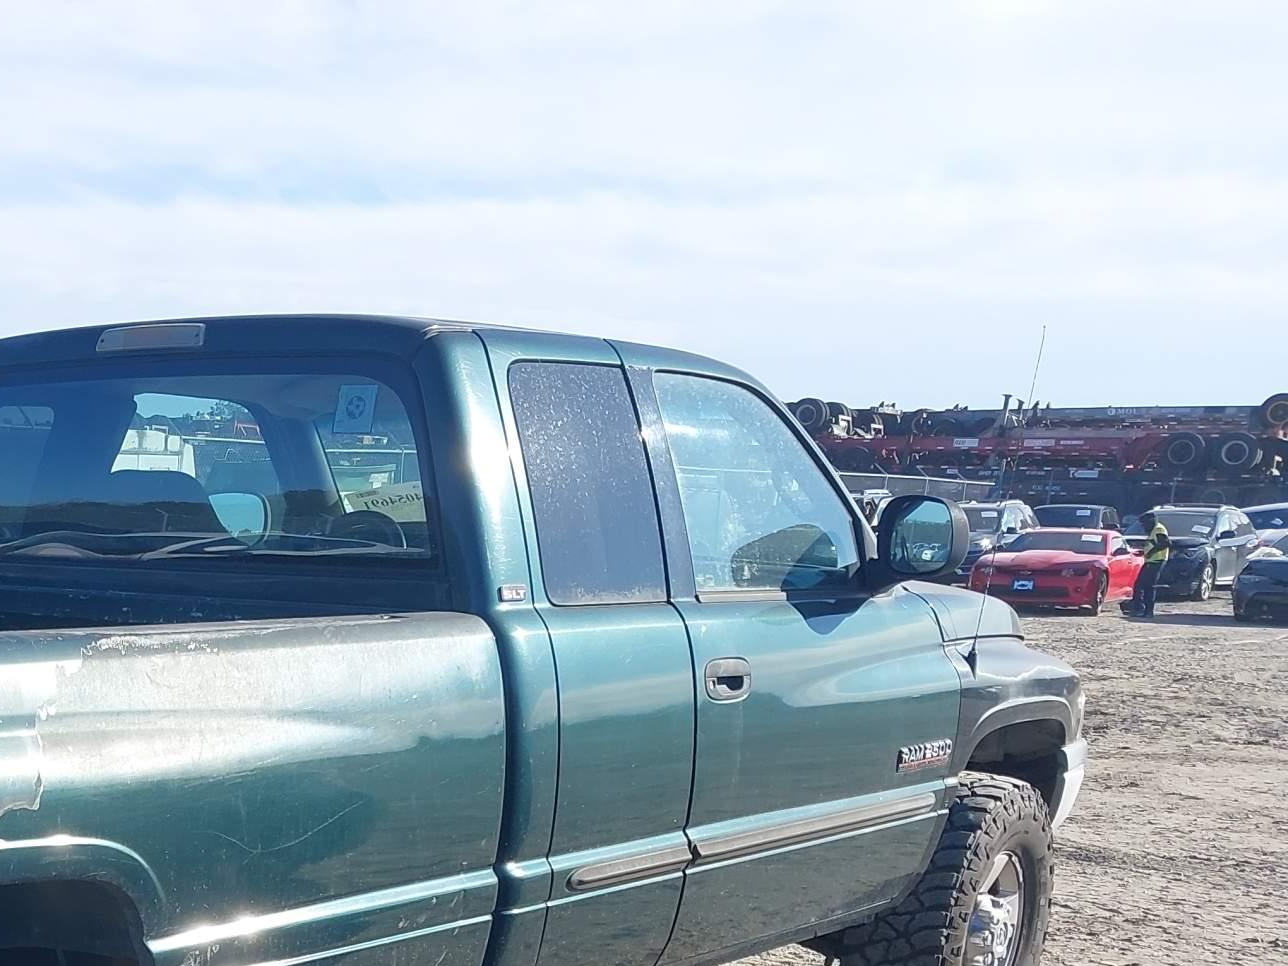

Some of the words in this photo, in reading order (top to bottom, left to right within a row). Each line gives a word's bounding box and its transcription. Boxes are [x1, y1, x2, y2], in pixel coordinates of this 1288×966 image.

[502, 589, 527, 600] SLT
[900, 743, 925, 765] RAM
[924, 738, 953, 758] 2500
